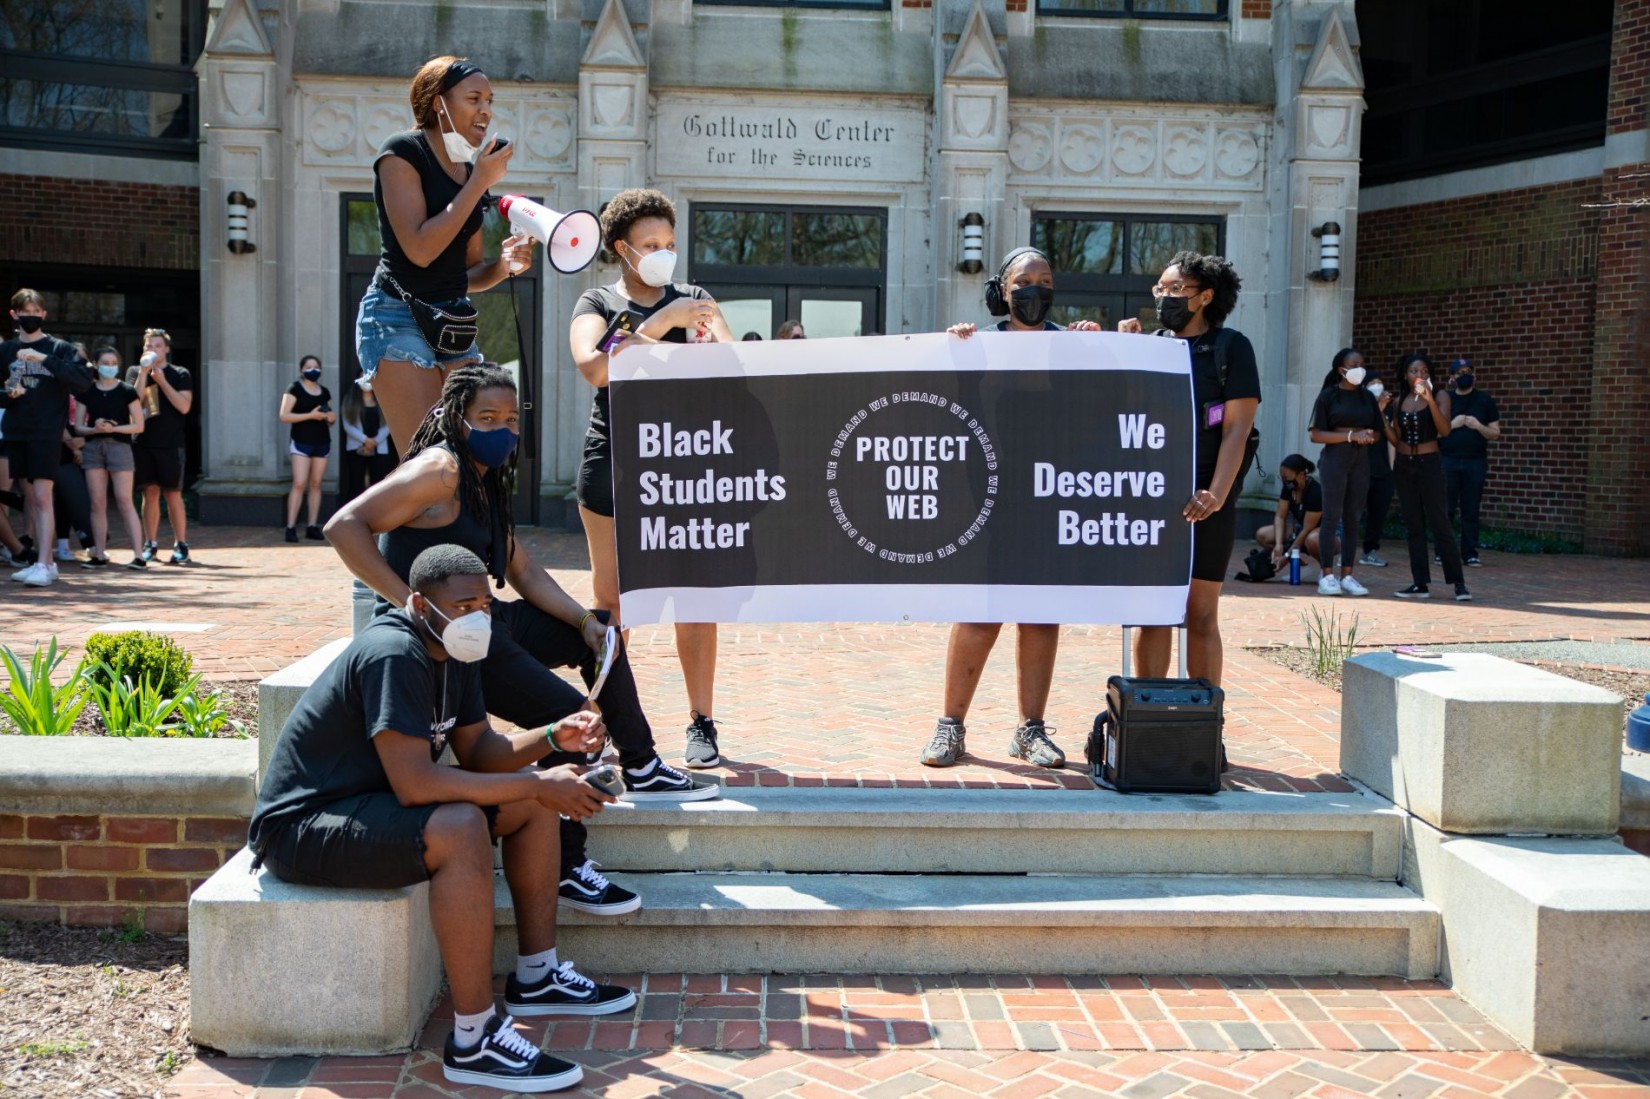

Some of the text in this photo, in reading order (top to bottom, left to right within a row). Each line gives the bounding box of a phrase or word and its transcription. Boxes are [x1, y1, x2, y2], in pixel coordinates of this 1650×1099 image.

[684, 115, 895, 143] Gottwald Center
[707, 146, 872, 169] for the Sciences
[639, 420, 734, 458] Black
[857, 436, 969, 461] PROTECT
[1118, 413, 1165, 450] We
[639, 468, 787, 506] Students
[827, 392, 998, 563] WE DEMAND WE DEMAND WE DEMAND WE DEMAND WE DEMAND WE DEMAND
[885, 465, 939, 491] OUR
[1034, 462, 1166, 498] Deserve
[886, 494, 938, 520] WEB
[640, 516, 750, 551] Matter
[1058, 509, 1166, 546] Better
